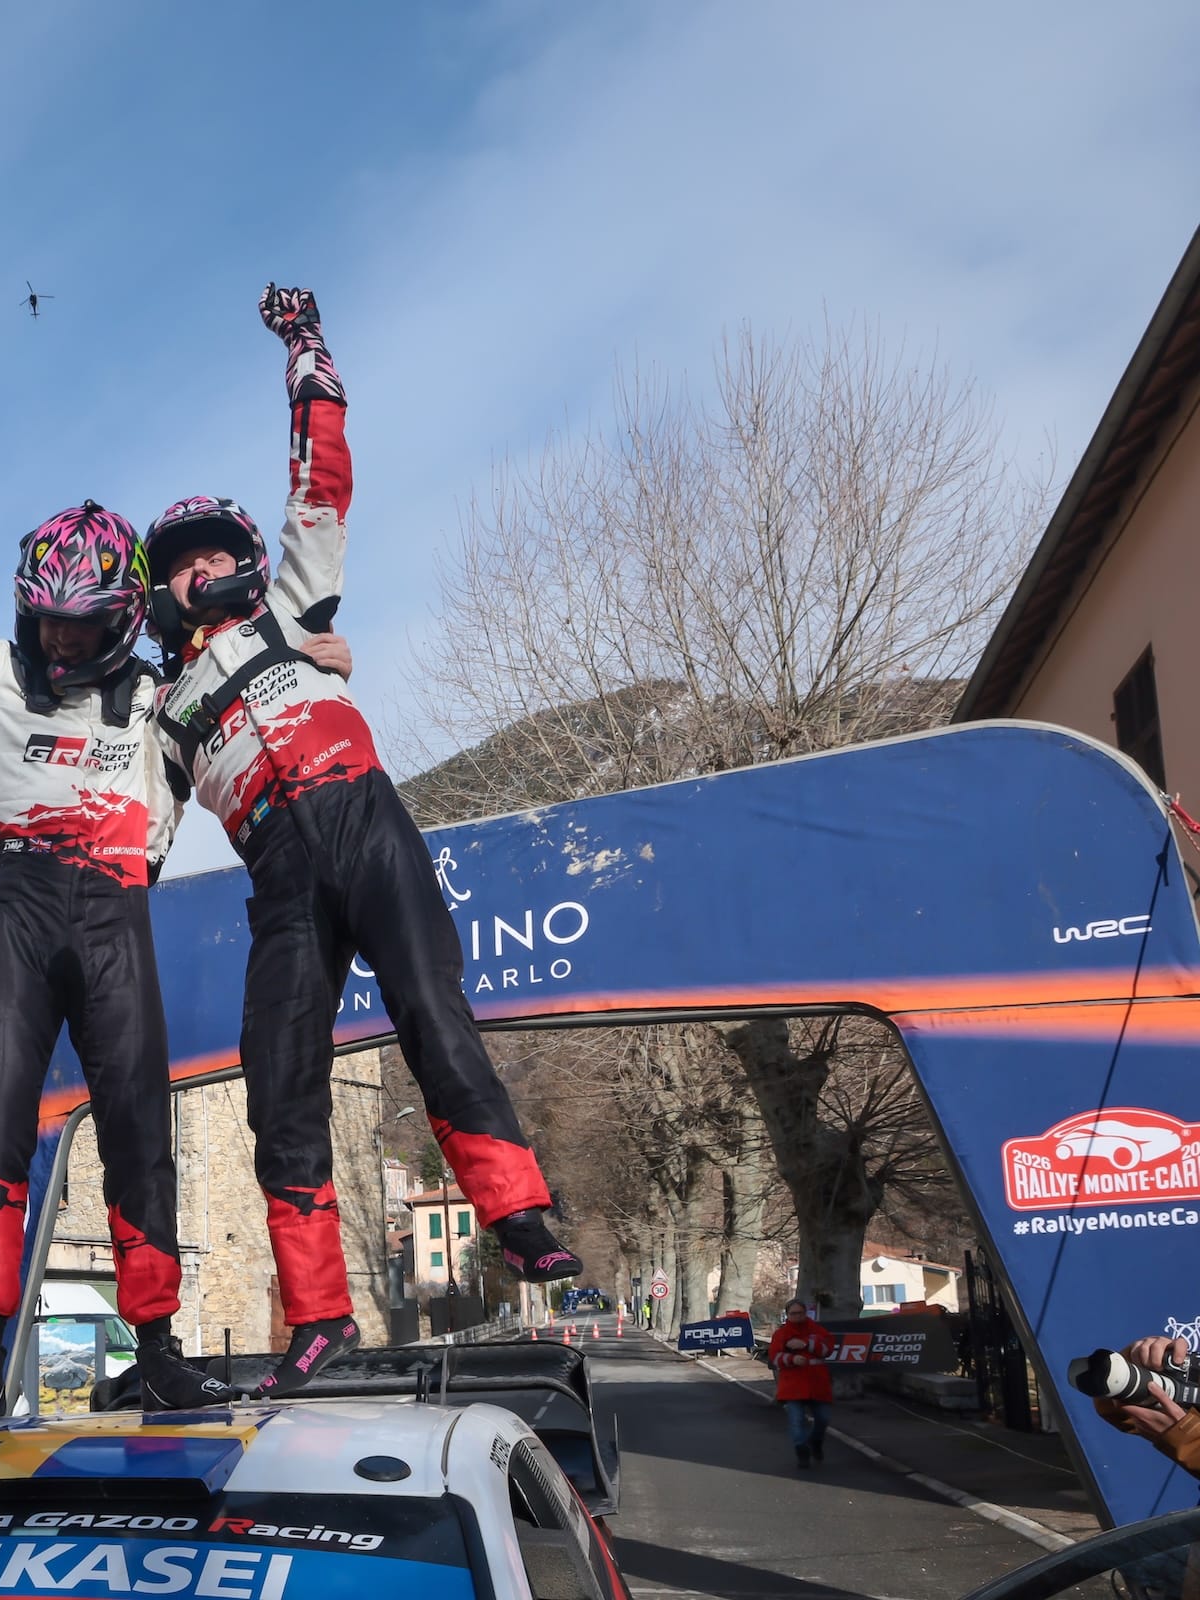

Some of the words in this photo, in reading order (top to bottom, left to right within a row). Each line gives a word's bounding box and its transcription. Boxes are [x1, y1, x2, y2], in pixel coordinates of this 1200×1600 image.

[245, 668, 296, 702] GAZOO
[249, 678, 298, 712] Racing
[23, 745, 84, 766] GR
[95, 738, 140, 751] TOYOTA
[313, 738, 352, 767] SOLBERG
[102, 846, 145, 857] EDMONDSON
[1053, 914, 1153, 944] WRC
[460, 957, 573, 995] ARLO
[1012, 1149, 1052, 1171] 2026
[1013, 1161, 1080, 1201] RALLYE
[1083, 1157, 1200, 1194] MONTE-CAR
[655, 1286, 665, 1295] 30
[872, 1343, 922, 1353] GAZOO
[875, 1333, 927, 1343] TOYOTA
[23, 1511, 199, 1531] GAZOO
[208, 1516, 385, 1551] Racing
